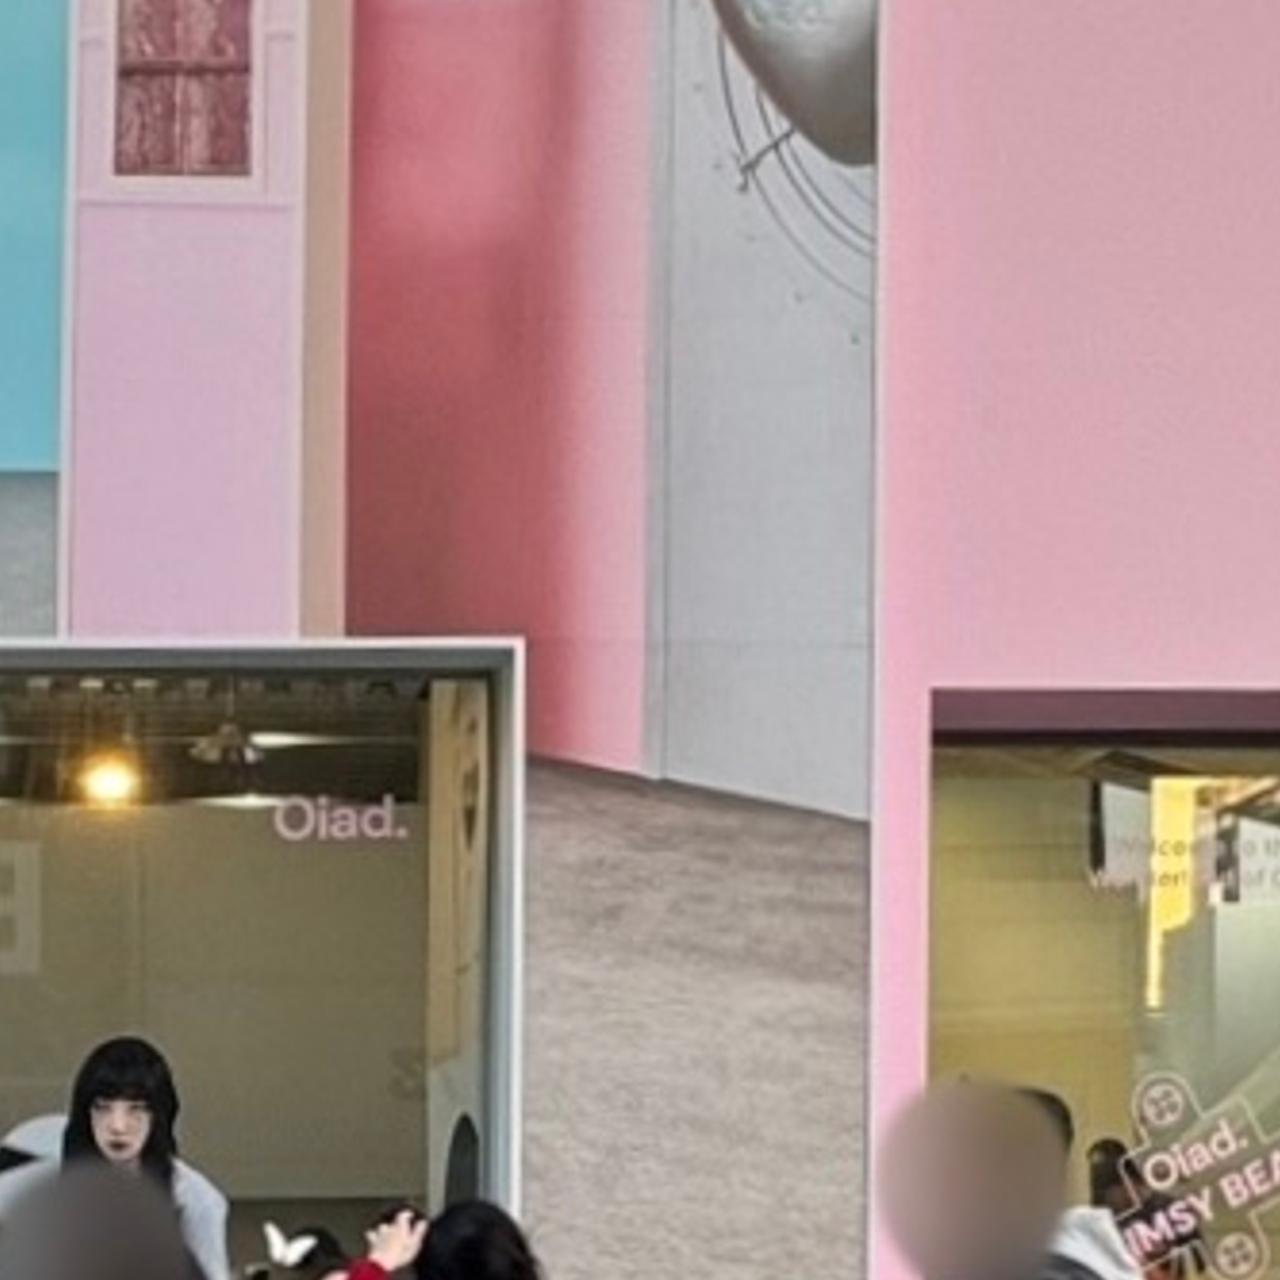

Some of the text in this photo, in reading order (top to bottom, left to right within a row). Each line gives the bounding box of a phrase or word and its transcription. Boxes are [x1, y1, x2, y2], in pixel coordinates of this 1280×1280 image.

[273, 796, 409, 840] Oiad.
[1144, 1117, 1249, 1190] Oiad.
[1124, 1186, 1214, 1265] IMSY
